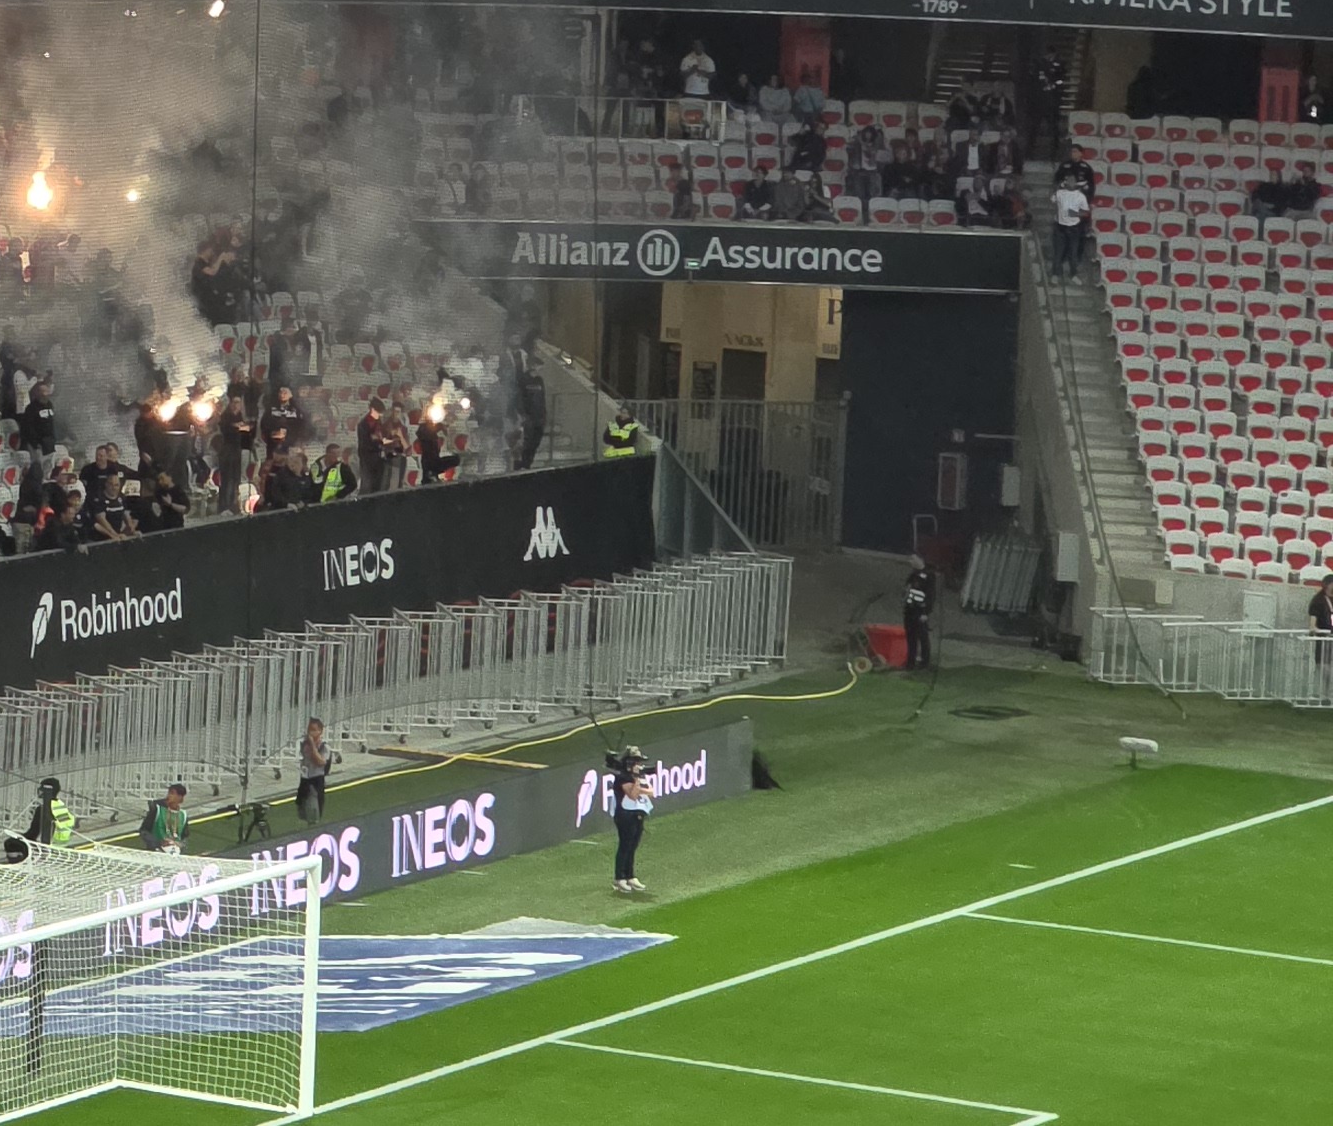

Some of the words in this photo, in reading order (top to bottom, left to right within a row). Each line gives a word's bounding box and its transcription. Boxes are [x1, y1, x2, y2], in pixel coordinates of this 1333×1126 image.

[511, 231, 631, 267] Allianz
[701, 236, 884, 273] Assurance
[322, 537, 395, 592] INEOS
[60, 578, 182, 643] Robinhood
[250, 825, 361, 916] INEOS
[391, 792, 496, 878] INEOS
[103, 863, 221, 957] INEOS
